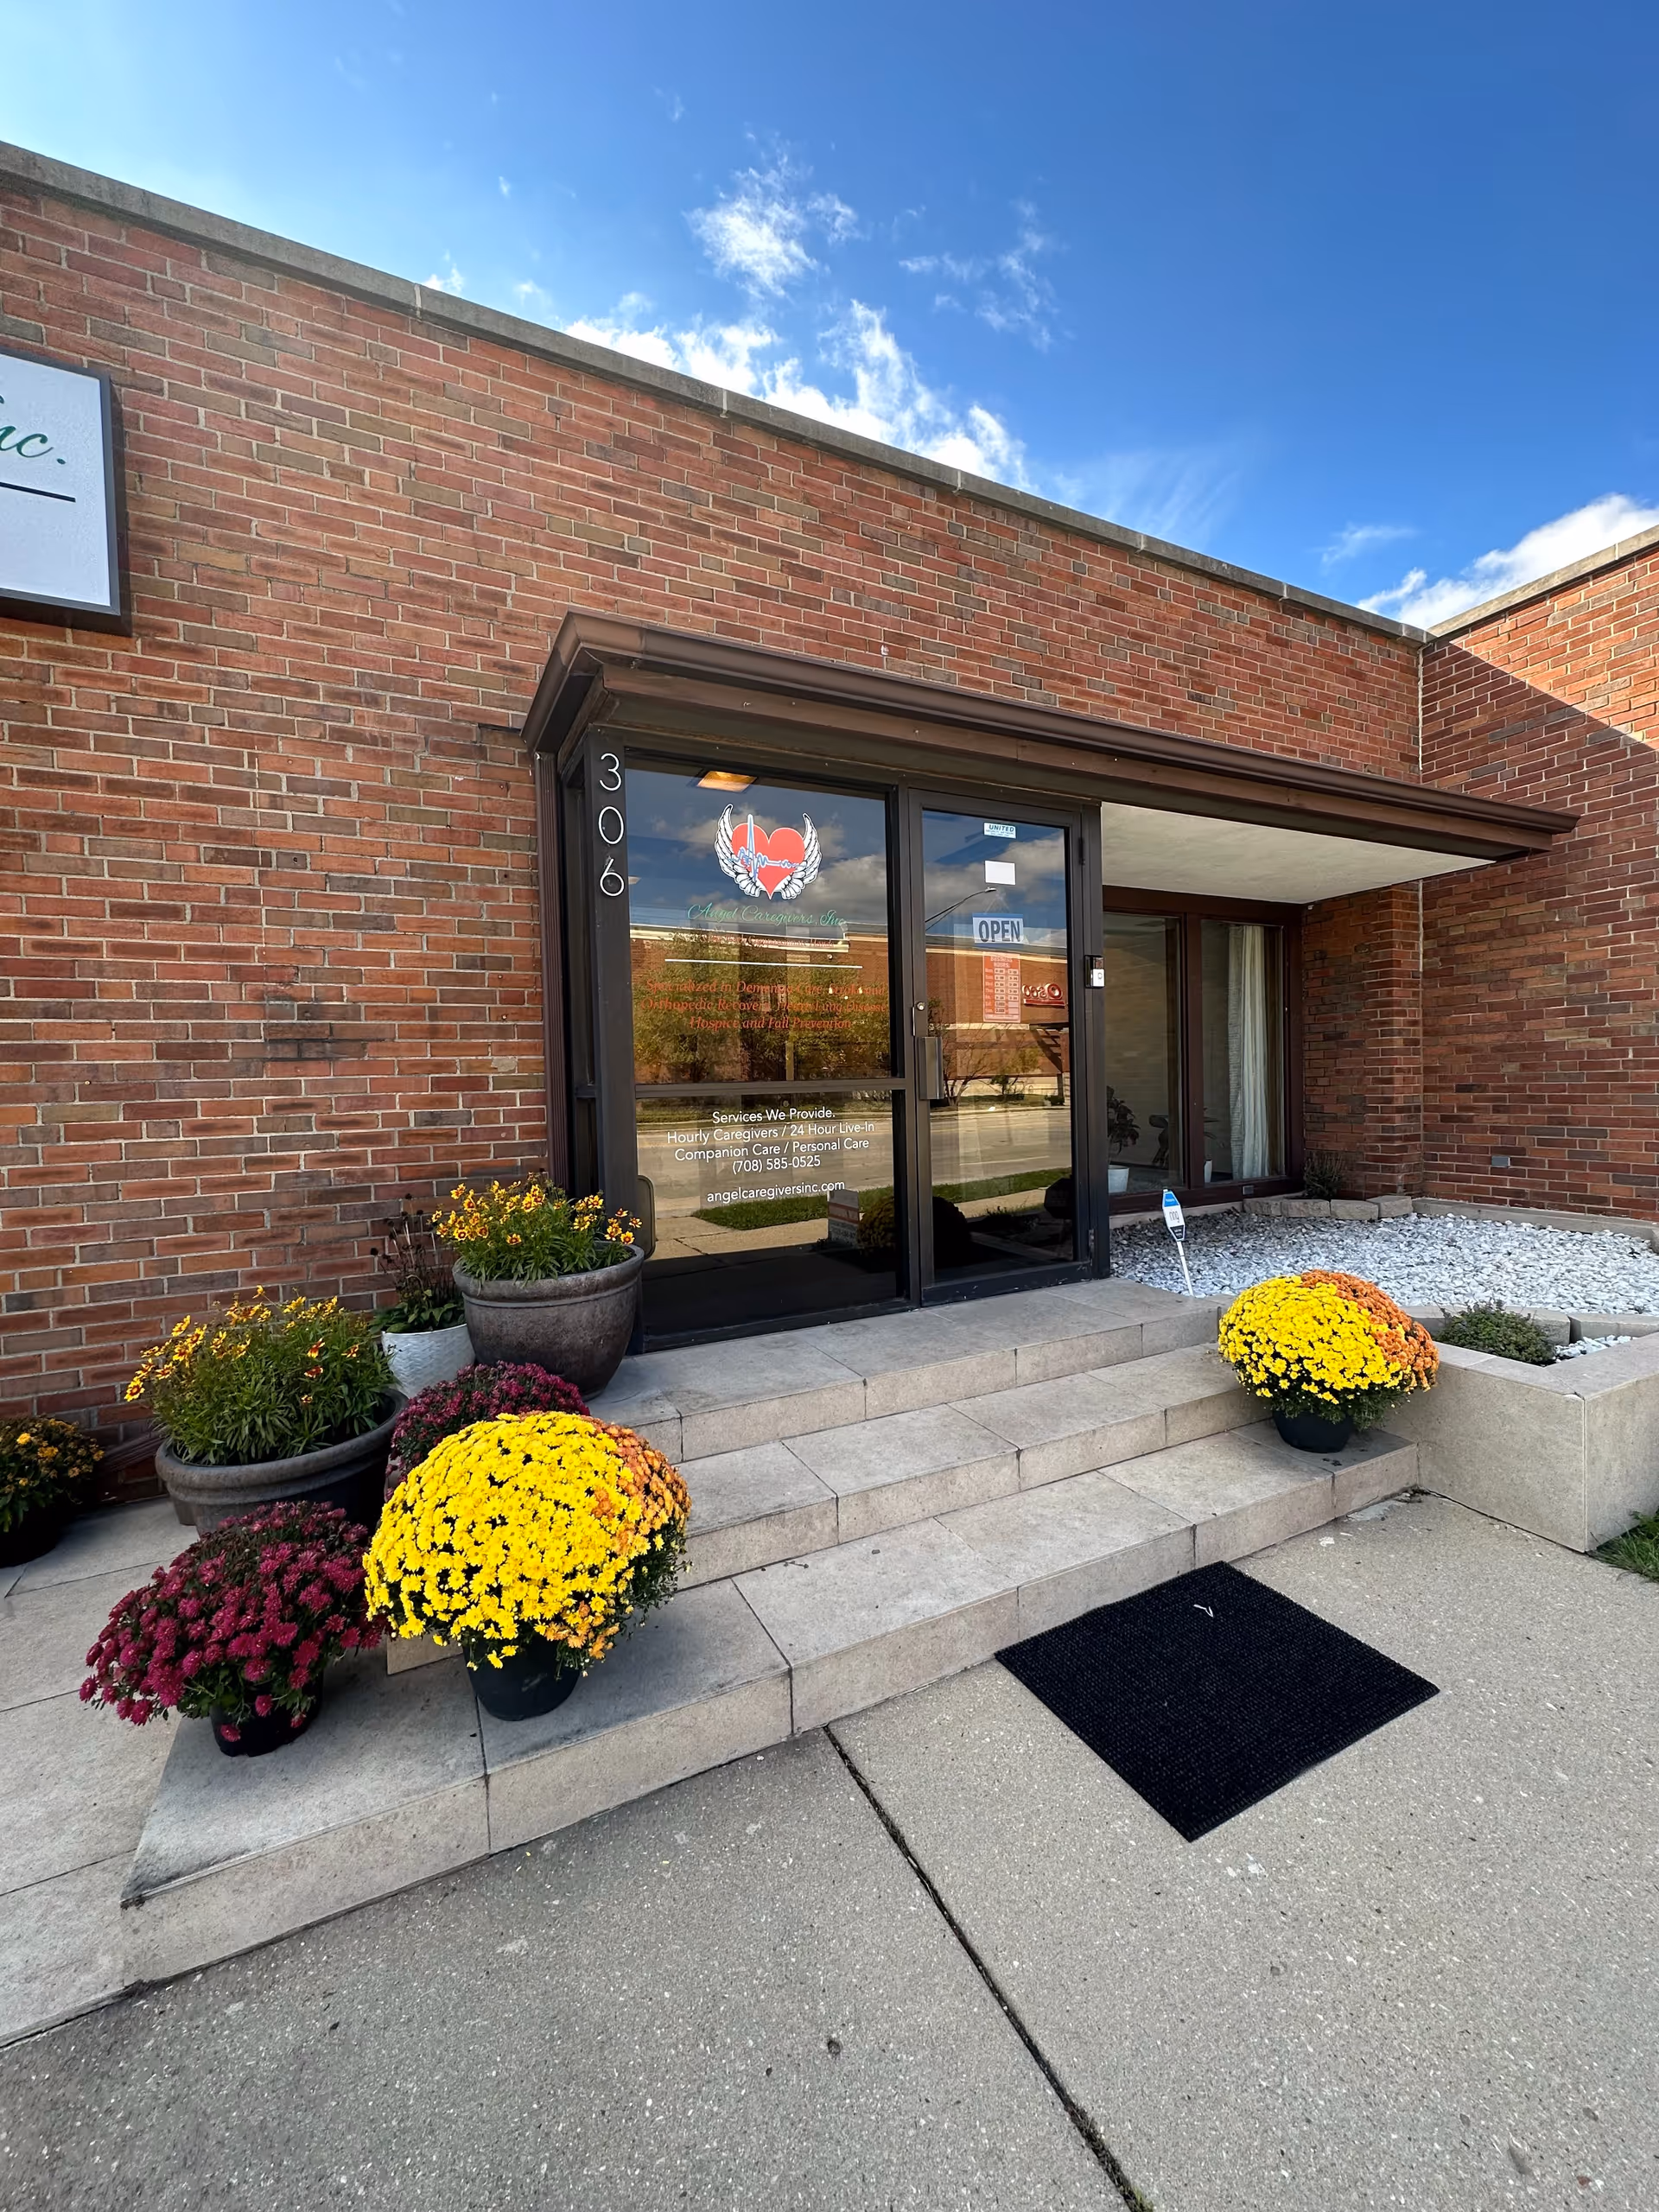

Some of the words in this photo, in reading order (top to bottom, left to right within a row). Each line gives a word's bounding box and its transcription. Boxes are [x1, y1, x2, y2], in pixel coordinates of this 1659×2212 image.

[599, 753, 626, 897] 306
[687, 902, 739, 923] Angel
[978, 919, 1020, 943] OPEN
[640, 996, 713, 1013] Orthopedic
[690, 1016, 740, 1032] Hospice
[742, 1016, 766, 1029] and
[767, 1016, 790, 1029] Fall
[791, 1016, 851, 1030] Prevention
[712, 1111, 763, 1124] Services
[765, 1109, 786, 1122] We
[667, 1128, 709, 1145] Hourly
[713, 1126, 779, 1142] Caregivers
[780, 1125, 787, 1137] /
[790, 1124, 805, 1137] 24
[808, 1122, 836, 1135] Hour
[839, 1121, 875, 1135] Live-In
[675, 1145, 748, 1163] Companion
[752, 1143, 781, 1156] Care
[784, 1141, 790, 1154] /
[792, 1138, 841, 1153] Personal
[843, 1137, 870, 1150] Care
[732, 1159, 764, 1175] (708)
[766, 1155, 822, 1171] 585-0525
[707, 1181, 846, 1205] angelcaregiversinc.com
